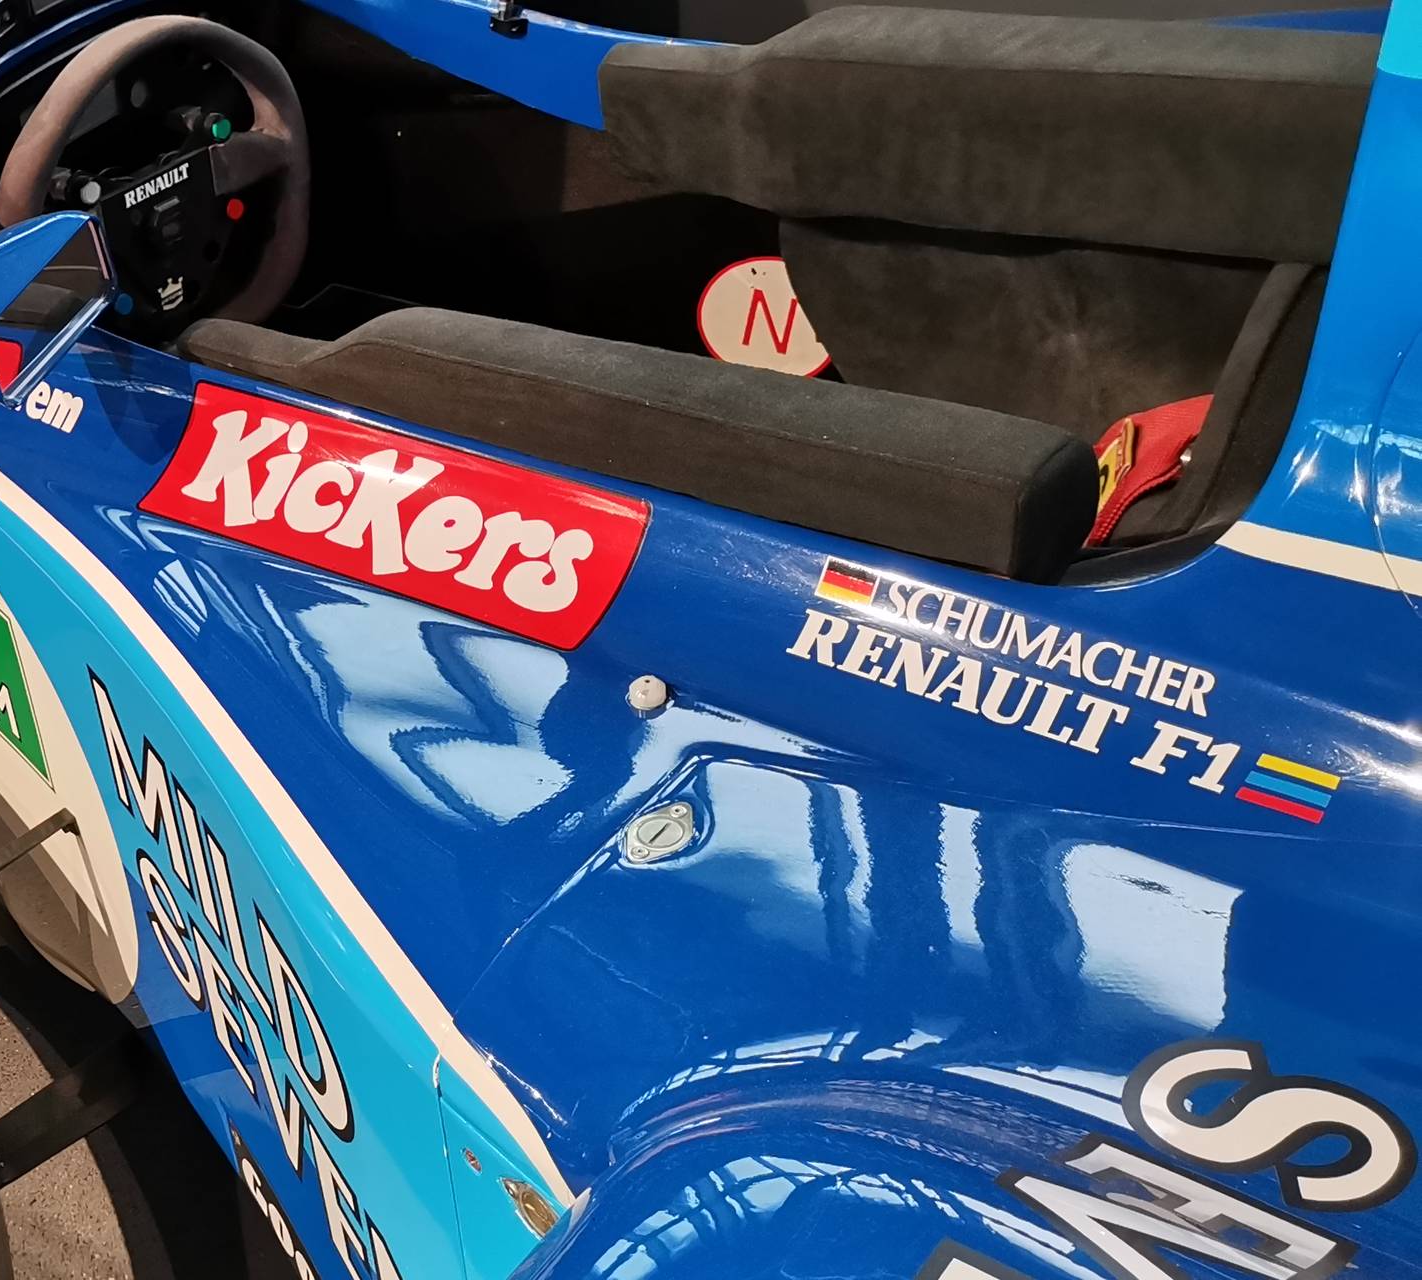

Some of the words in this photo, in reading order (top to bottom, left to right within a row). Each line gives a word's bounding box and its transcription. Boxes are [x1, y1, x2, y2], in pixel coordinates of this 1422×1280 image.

[124, 162, 189, 209] RENAULT
[741, 288, 798, 355] N
[786, 608, 1130, 754] RENAULT
[1130, 720, 1241, 795] F1
[882, 580, 1217, 717] SCHUMACHER
[87, 664, 355, 1143] MILD
[135, 849, 402, 1280] SEVE
